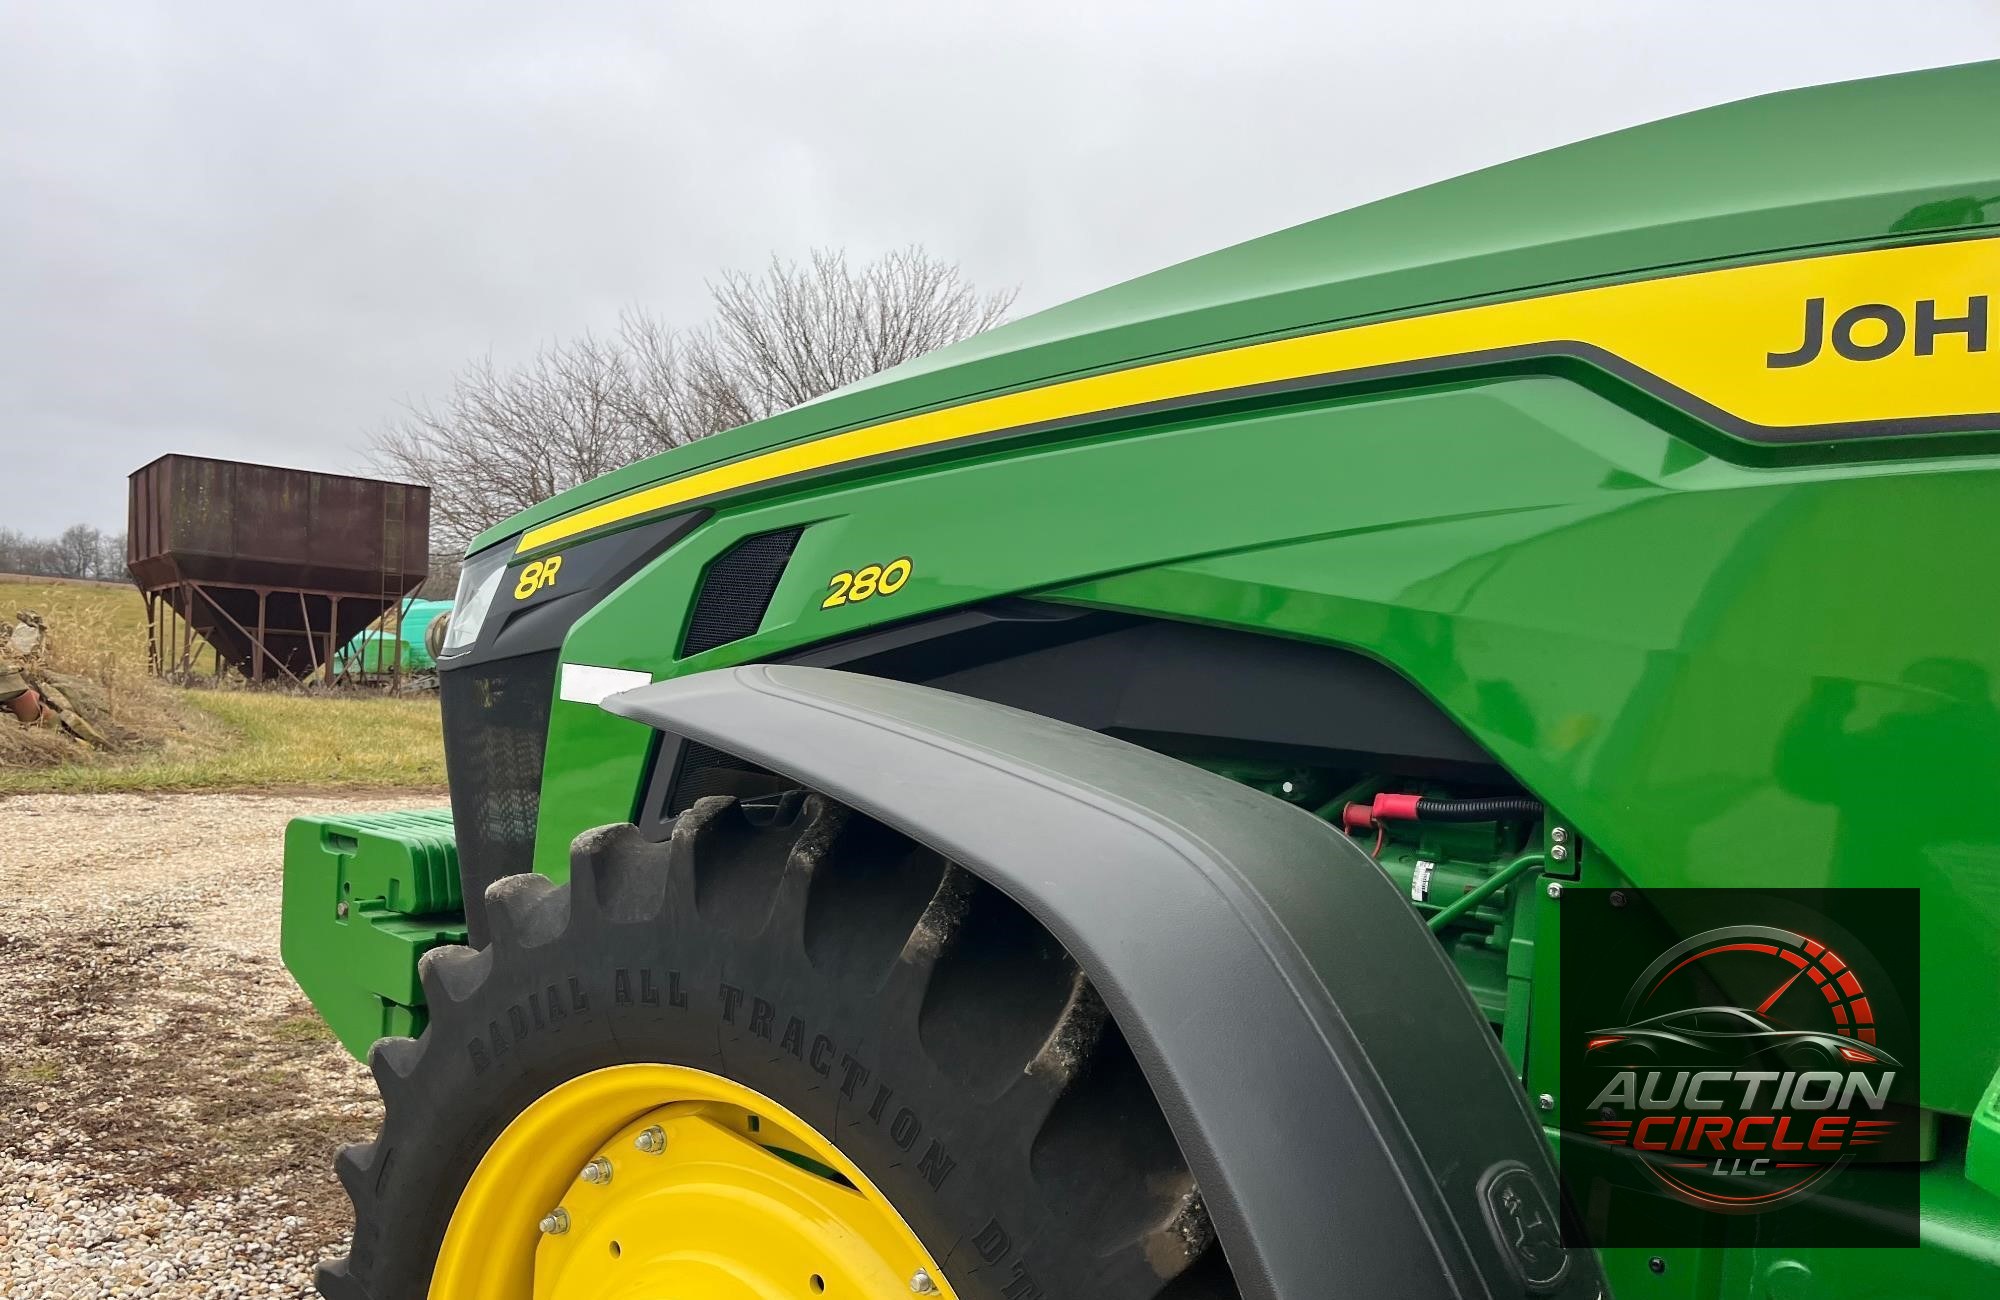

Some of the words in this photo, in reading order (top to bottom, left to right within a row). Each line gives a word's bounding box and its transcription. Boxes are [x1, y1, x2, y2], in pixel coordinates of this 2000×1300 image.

[513, 554, 562, 601] 8R
[820, 556, 913, 611] 280
[468, 976, 590, 1076] RADIAL
[615, 968, 688, 1010] ALL
[719, 983, 956, 1193] TRACTION
